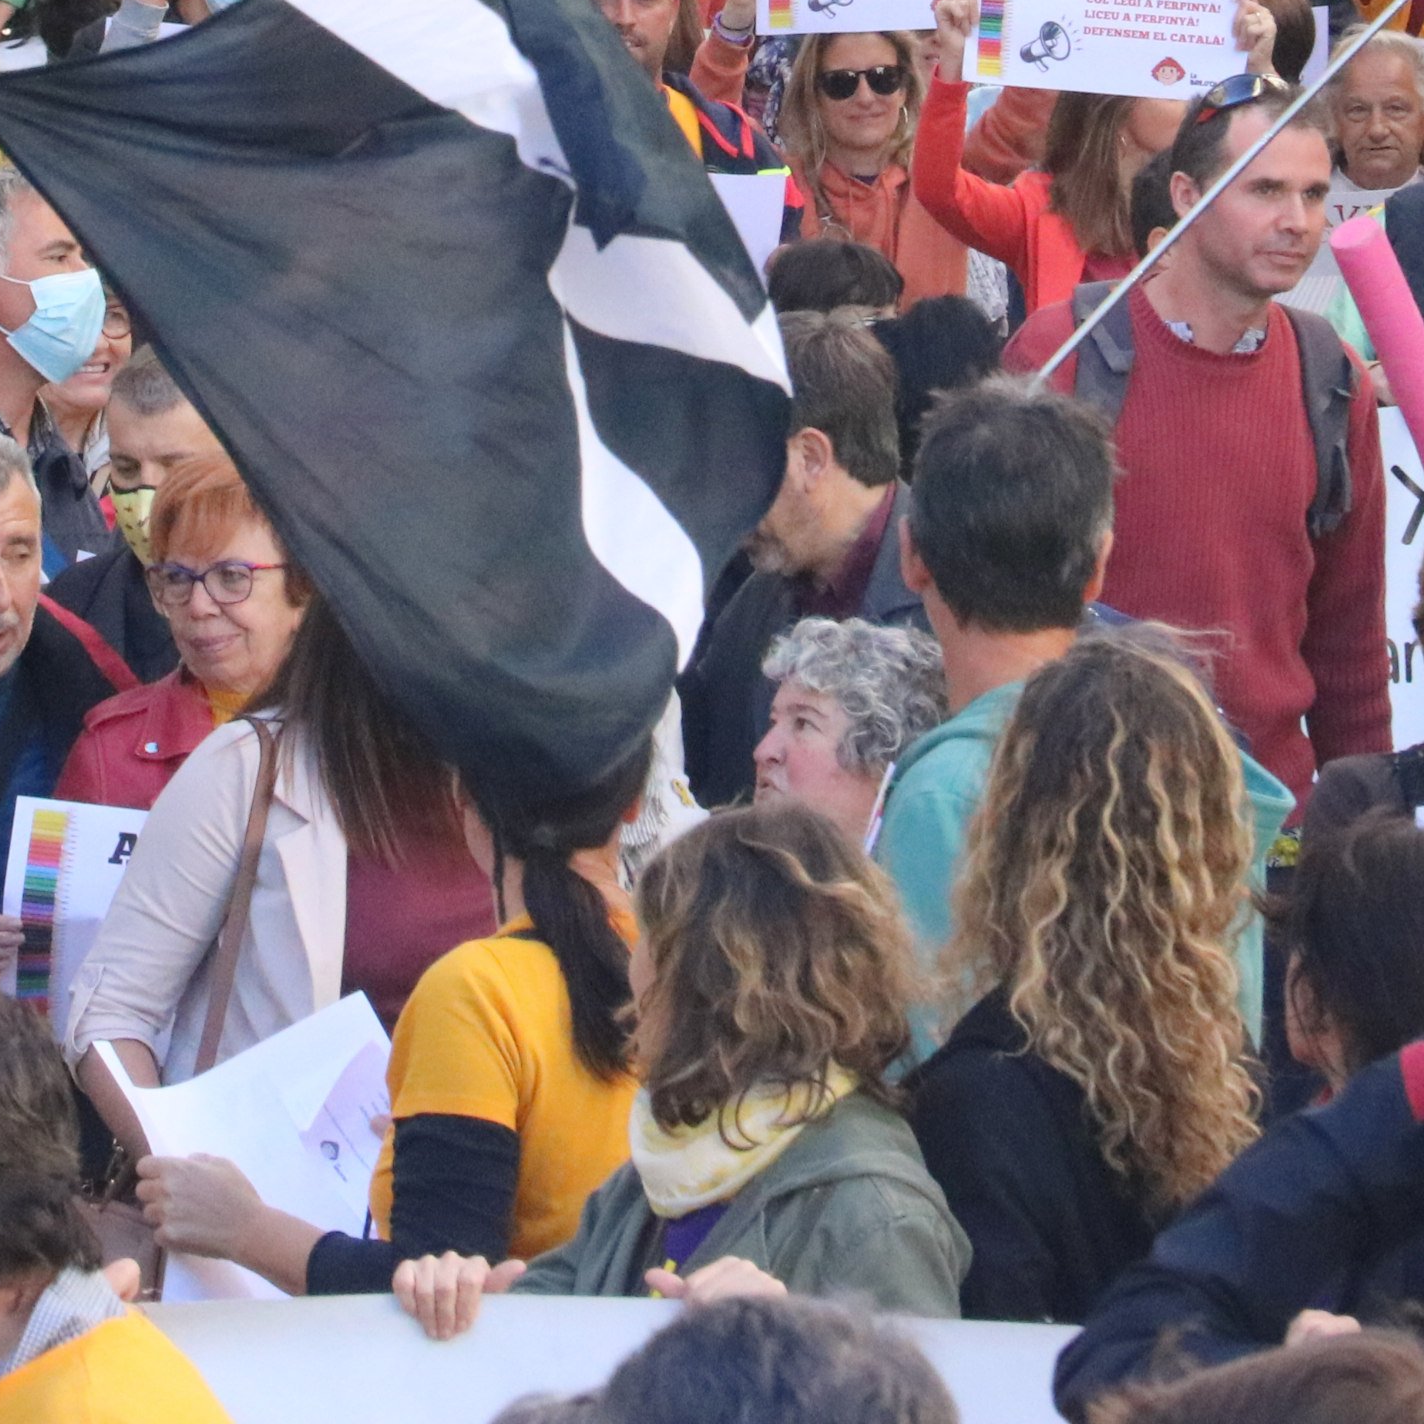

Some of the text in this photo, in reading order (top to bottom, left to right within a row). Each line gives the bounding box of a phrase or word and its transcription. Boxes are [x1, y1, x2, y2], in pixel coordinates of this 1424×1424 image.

[1144, 0, 1154, 9] A
[1156, 0, 1222, 14] PERPINYÀ!
[1084, 9, 1200, 27] LICEU A PERPINYÀ!
[1082, 26, 1225, 46] DEFENSEM EL CATALÀ!
